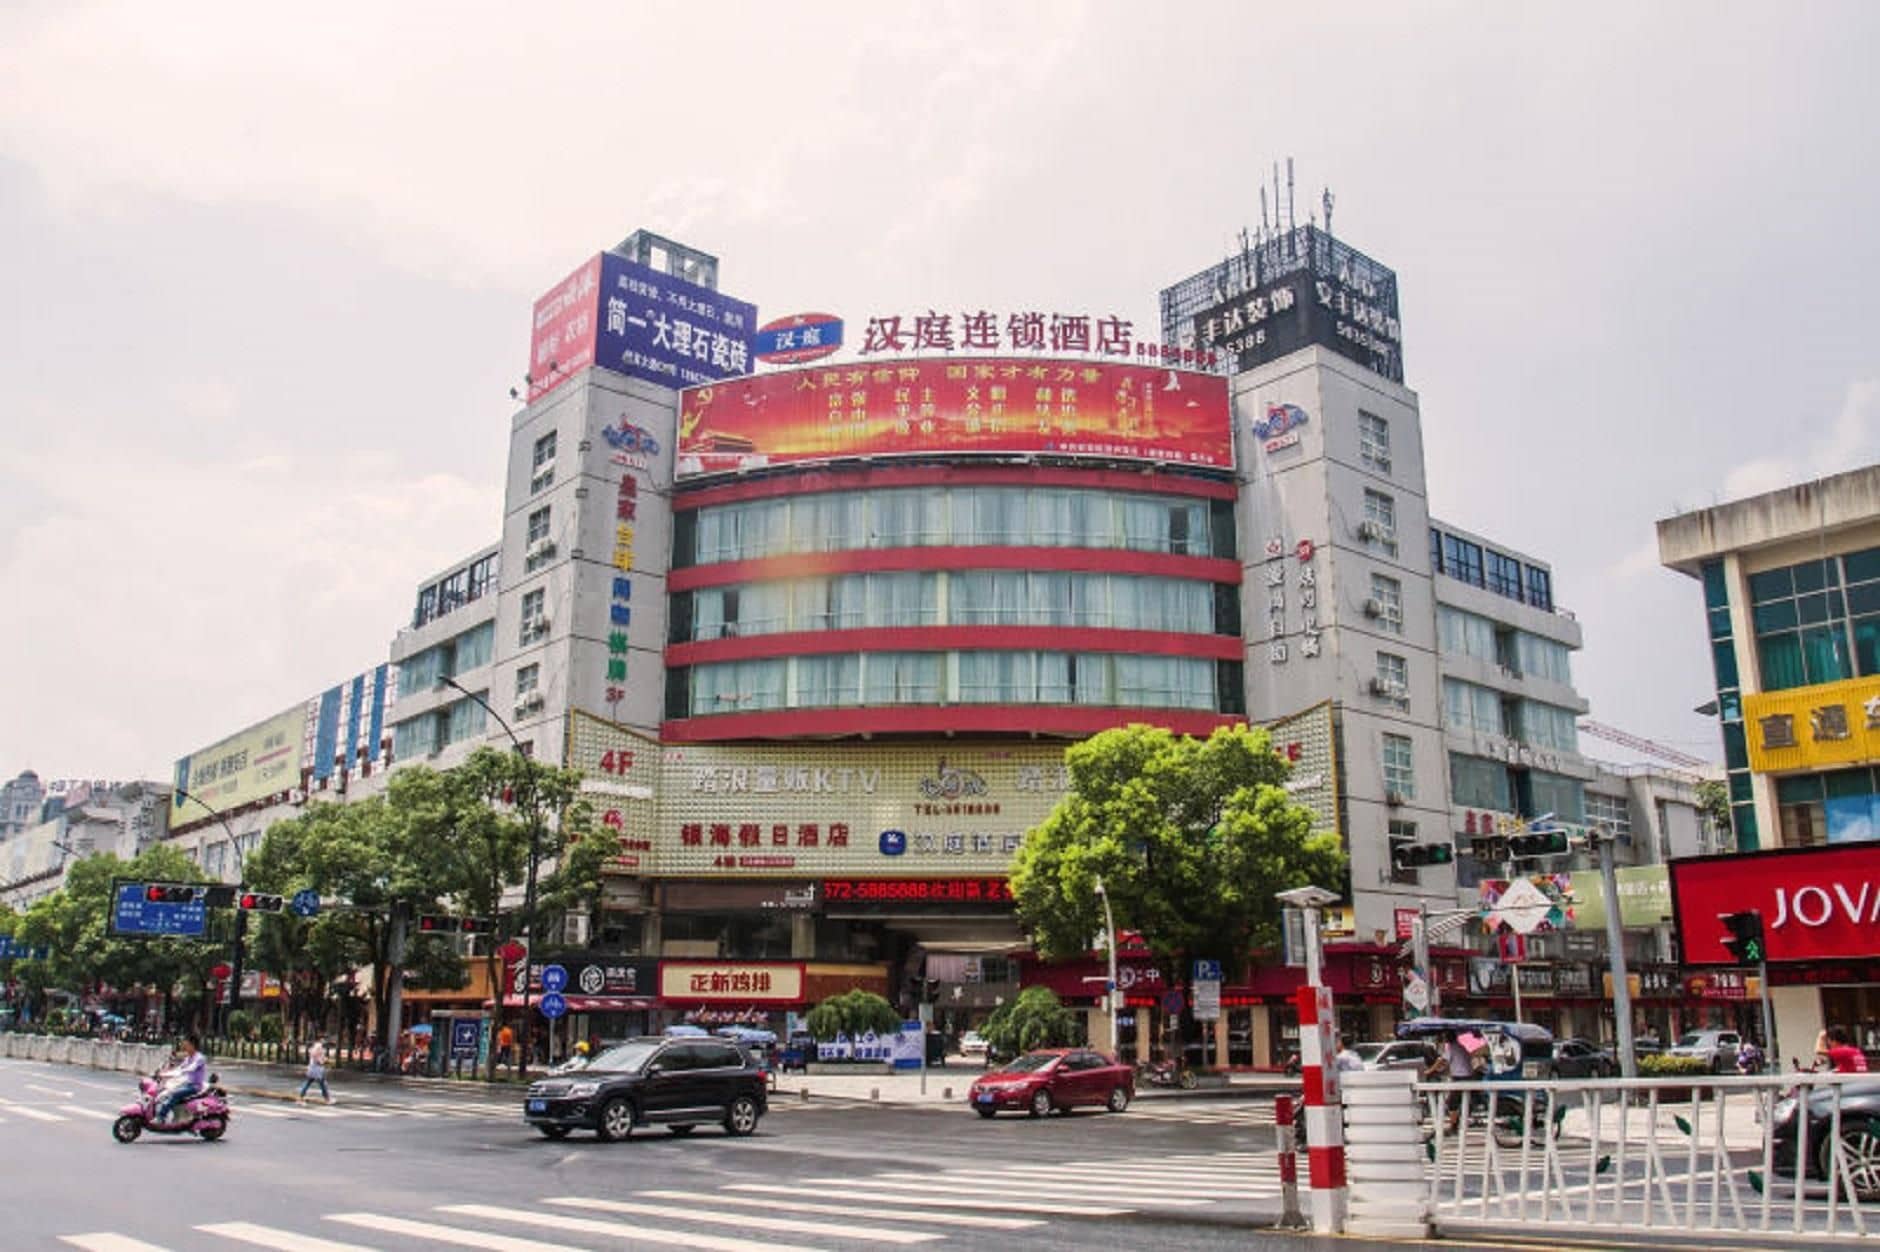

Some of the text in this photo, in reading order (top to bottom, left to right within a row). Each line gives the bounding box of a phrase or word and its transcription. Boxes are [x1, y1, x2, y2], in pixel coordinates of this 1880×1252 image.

[775, 326, 821, 351] 汉庭
[862, 310, 1134, 357] 汉庭连锁酒店
[796, 364, 1103, 391] 人民有信仰 国家才有力量
[600, 749, 636, 776] 4F
[680, 822, 849, 848] 银海假日酒店
[1771, 880, 1880, 929] JOV
[689, 971, 772, 993] 正新鸡排
